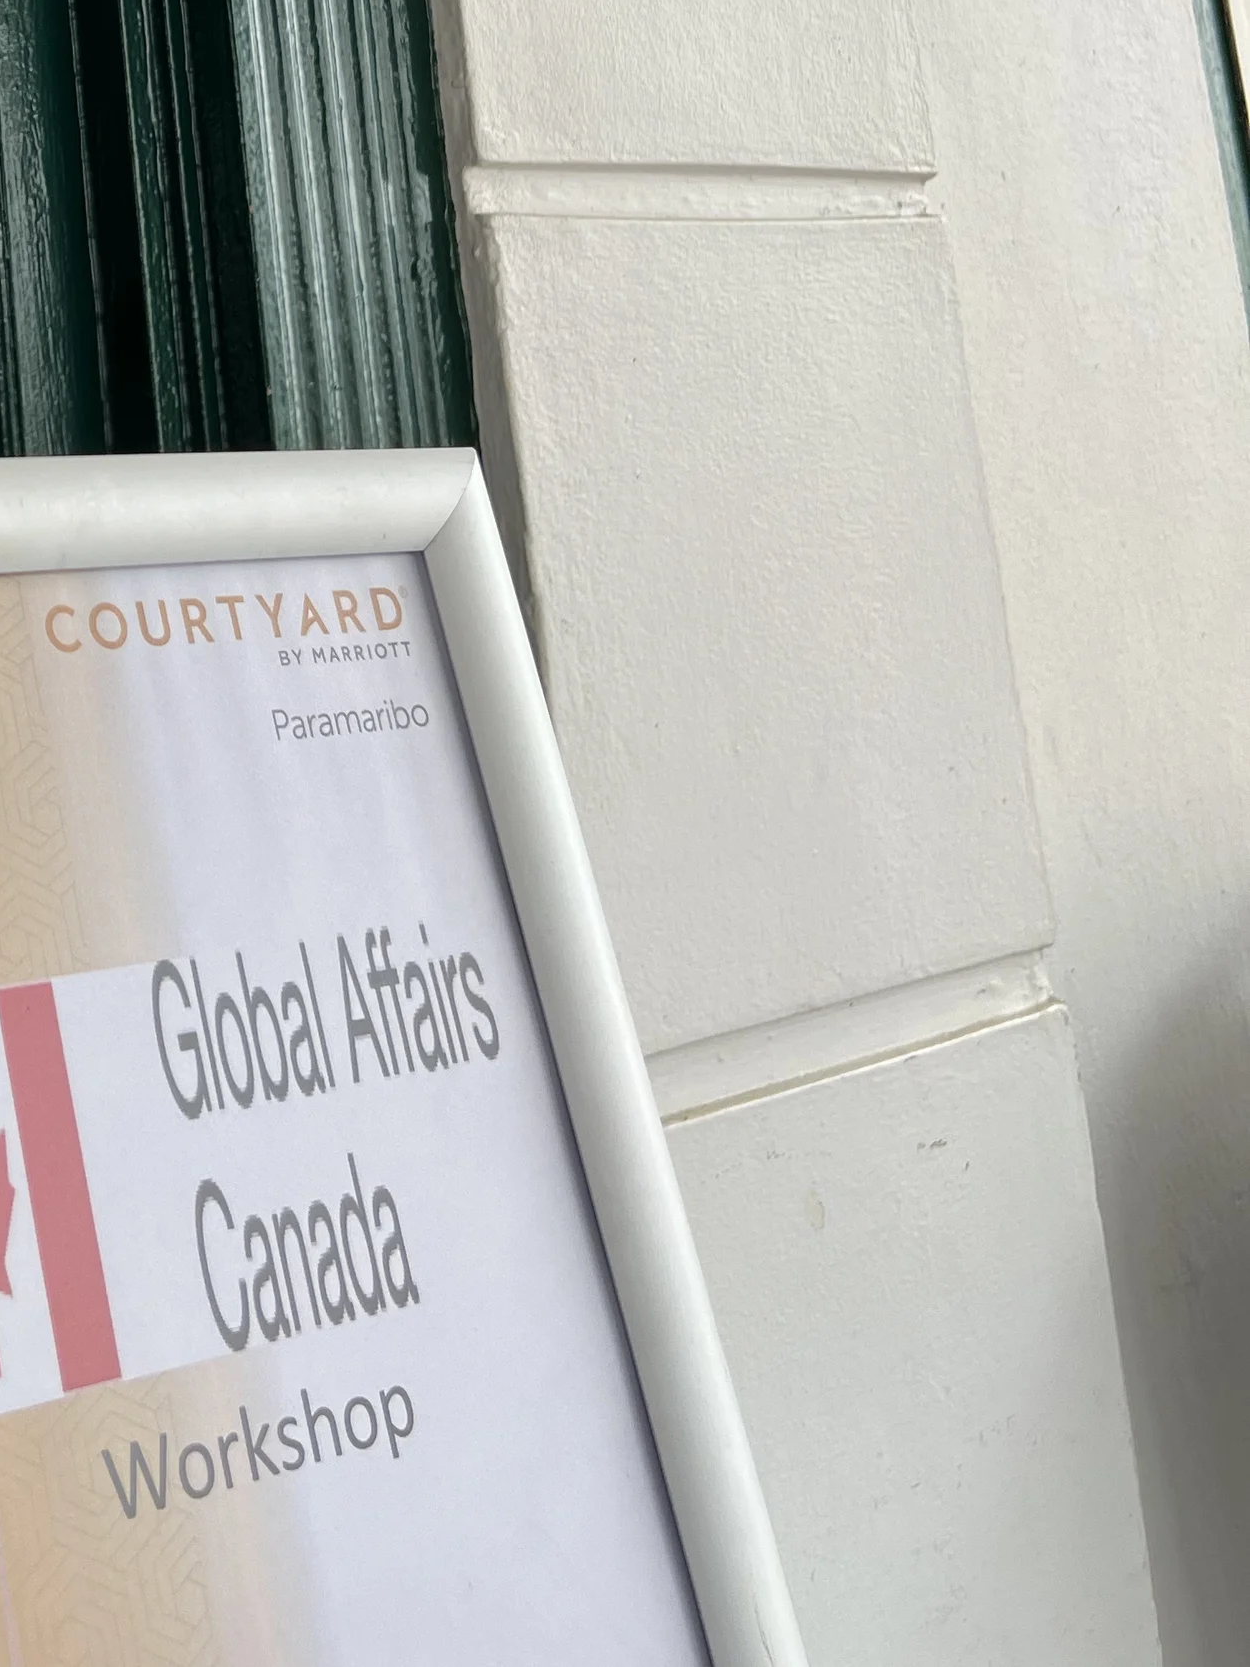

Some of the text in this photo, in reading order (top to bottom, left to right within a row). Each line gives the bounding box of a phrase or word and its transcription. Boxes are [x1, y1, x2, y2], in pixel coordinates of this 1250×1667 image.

[44, 586, 403, 654] COURTYARD
[278, 640, 412, 667] BY MARRIOTT
[271, 699, 430, 741] Paramaribo
[152, 920, 500, 1120] Global Affairs
[195, 1151, 420, 1352] Canada
[101, 1384, 415, 1520] Workshop
